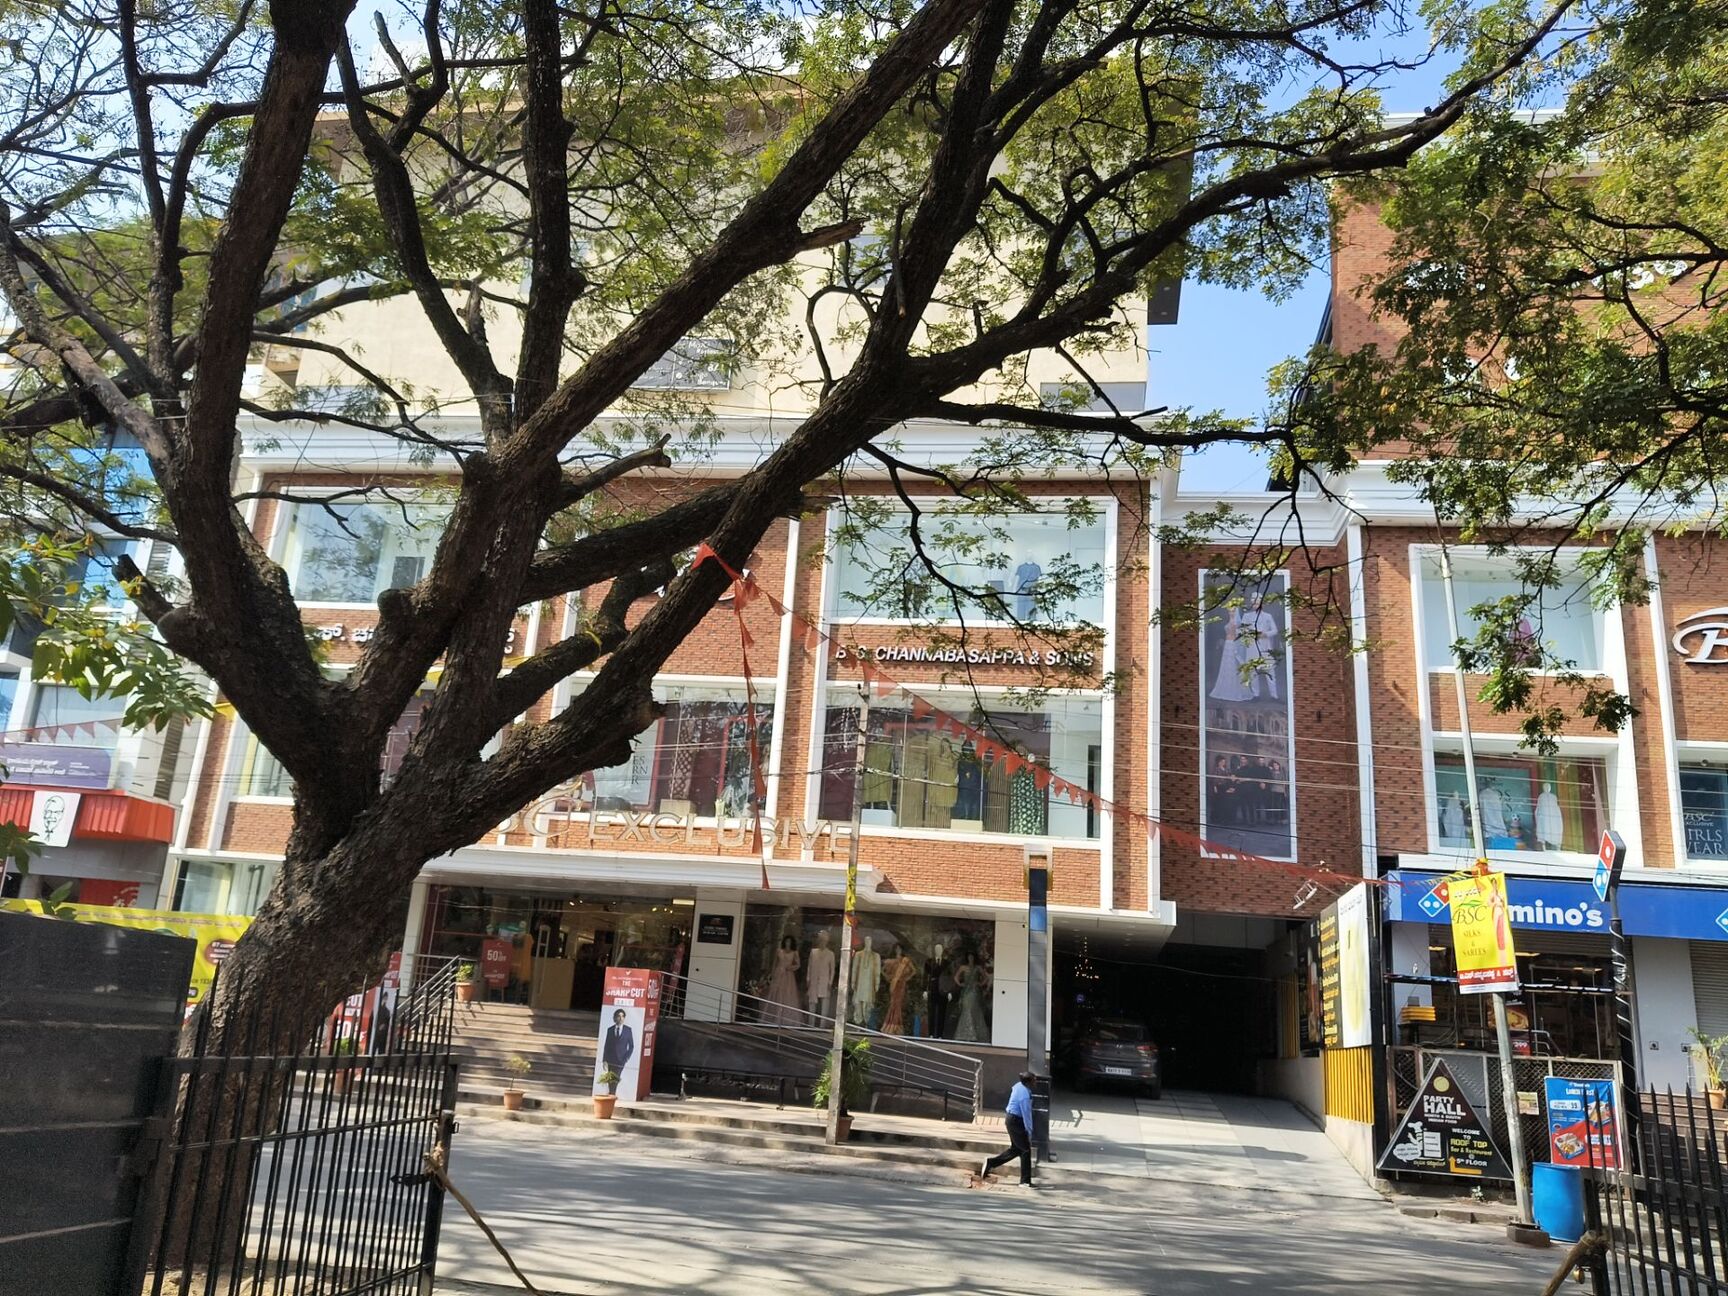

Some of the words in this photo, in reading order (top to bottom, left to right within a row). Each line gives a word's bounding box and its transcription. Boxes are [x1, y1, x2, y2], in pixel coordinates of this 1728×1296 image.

[1028, 650, 1040, 665] &
[588, 810, 852, 852] EXCLUSIVE
[1453, 905, 1487, 925] BSC
[1508, 899, 1603, 927] mino's
[630, 987, 646, 998] CUT
[1423, 1095, 1454, 1104] PARTY
[1423, 1101, 1466, 1116] HALL
[1451, 1128, 1480, 1136] WELCOME
[1450, 1138, 1470, 1147] ROOF
[1473, 1140, 1488, 1149] TOP
[1465, 1158, 1488, 1167] FLOOR
